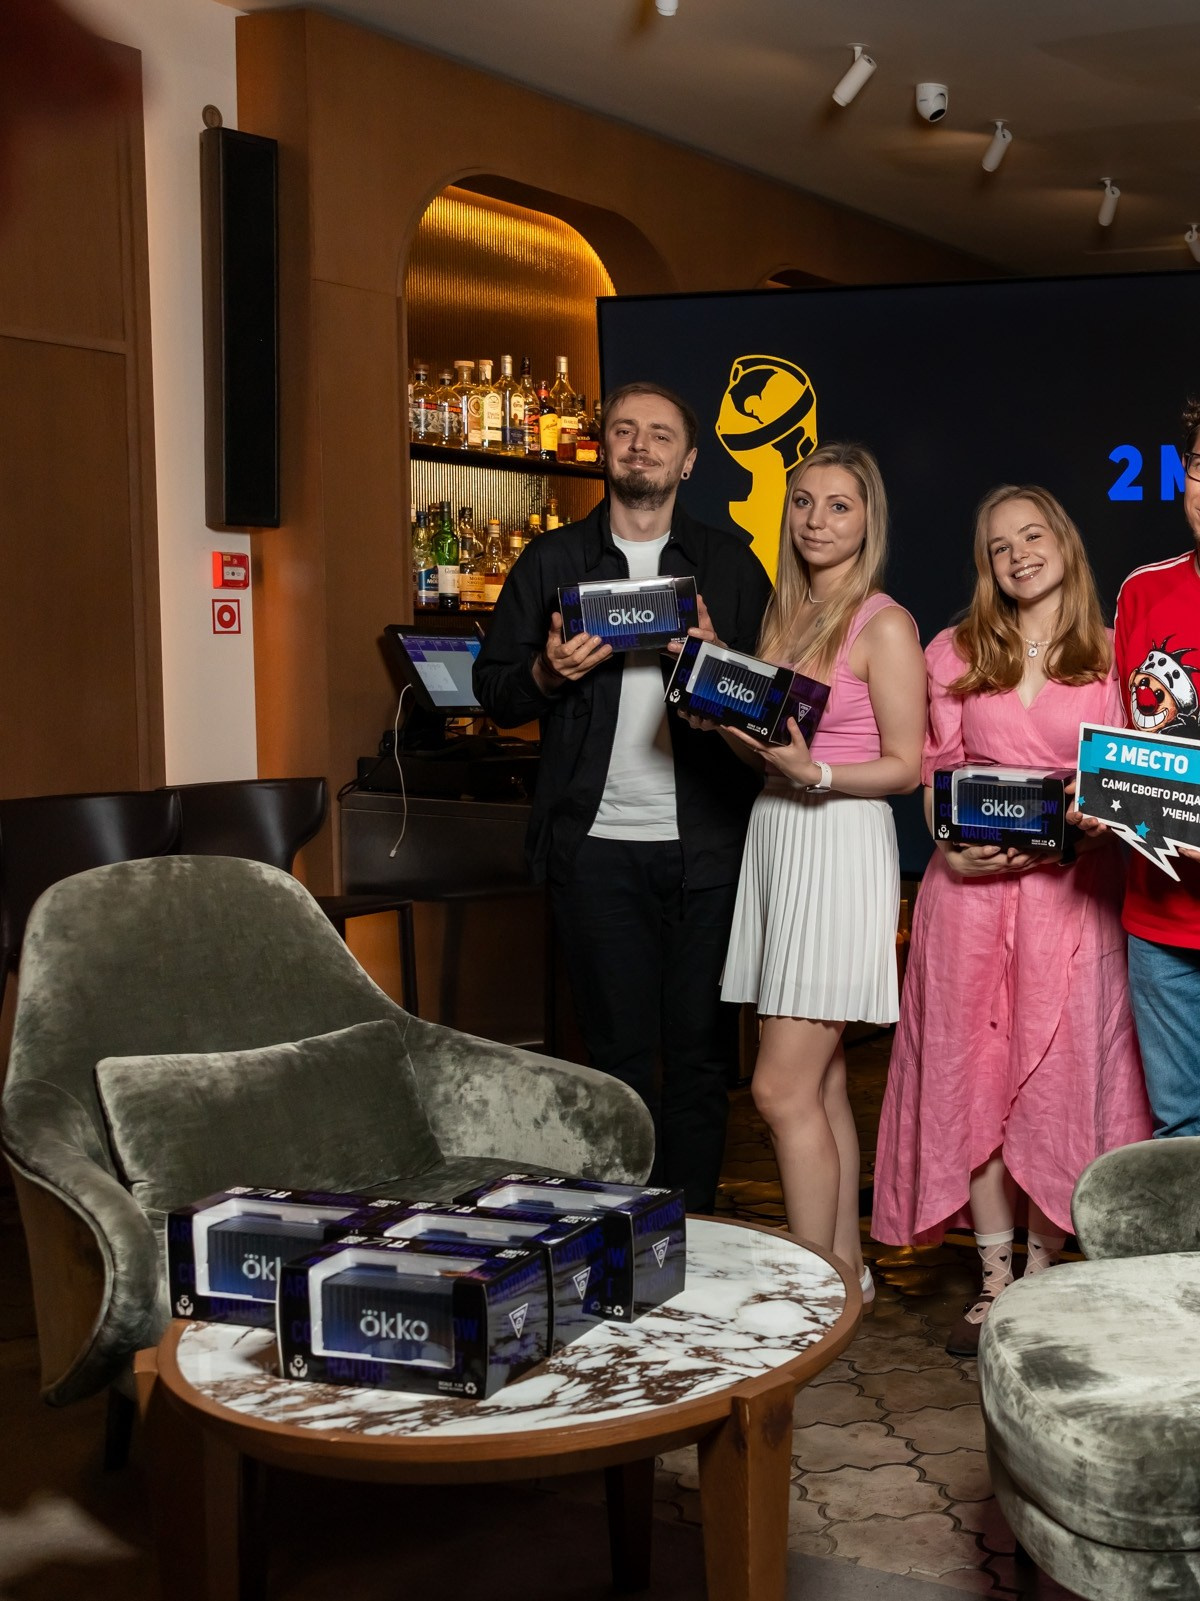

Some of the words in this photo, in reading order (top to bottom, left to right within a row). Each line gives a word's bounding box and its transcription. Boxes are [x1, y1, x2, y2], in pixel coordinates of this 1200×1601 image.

[1107, 443, 1144, 502] 2
[1105, 742, 1118, 762] 2
[1121, 746, 1189, 775] МЕСТО
[1101, 777, 1131, 793] САМИ
[1132, 784, 1171, 800] СВОЕГО
[960, 826, 1003, 842] NATURE
